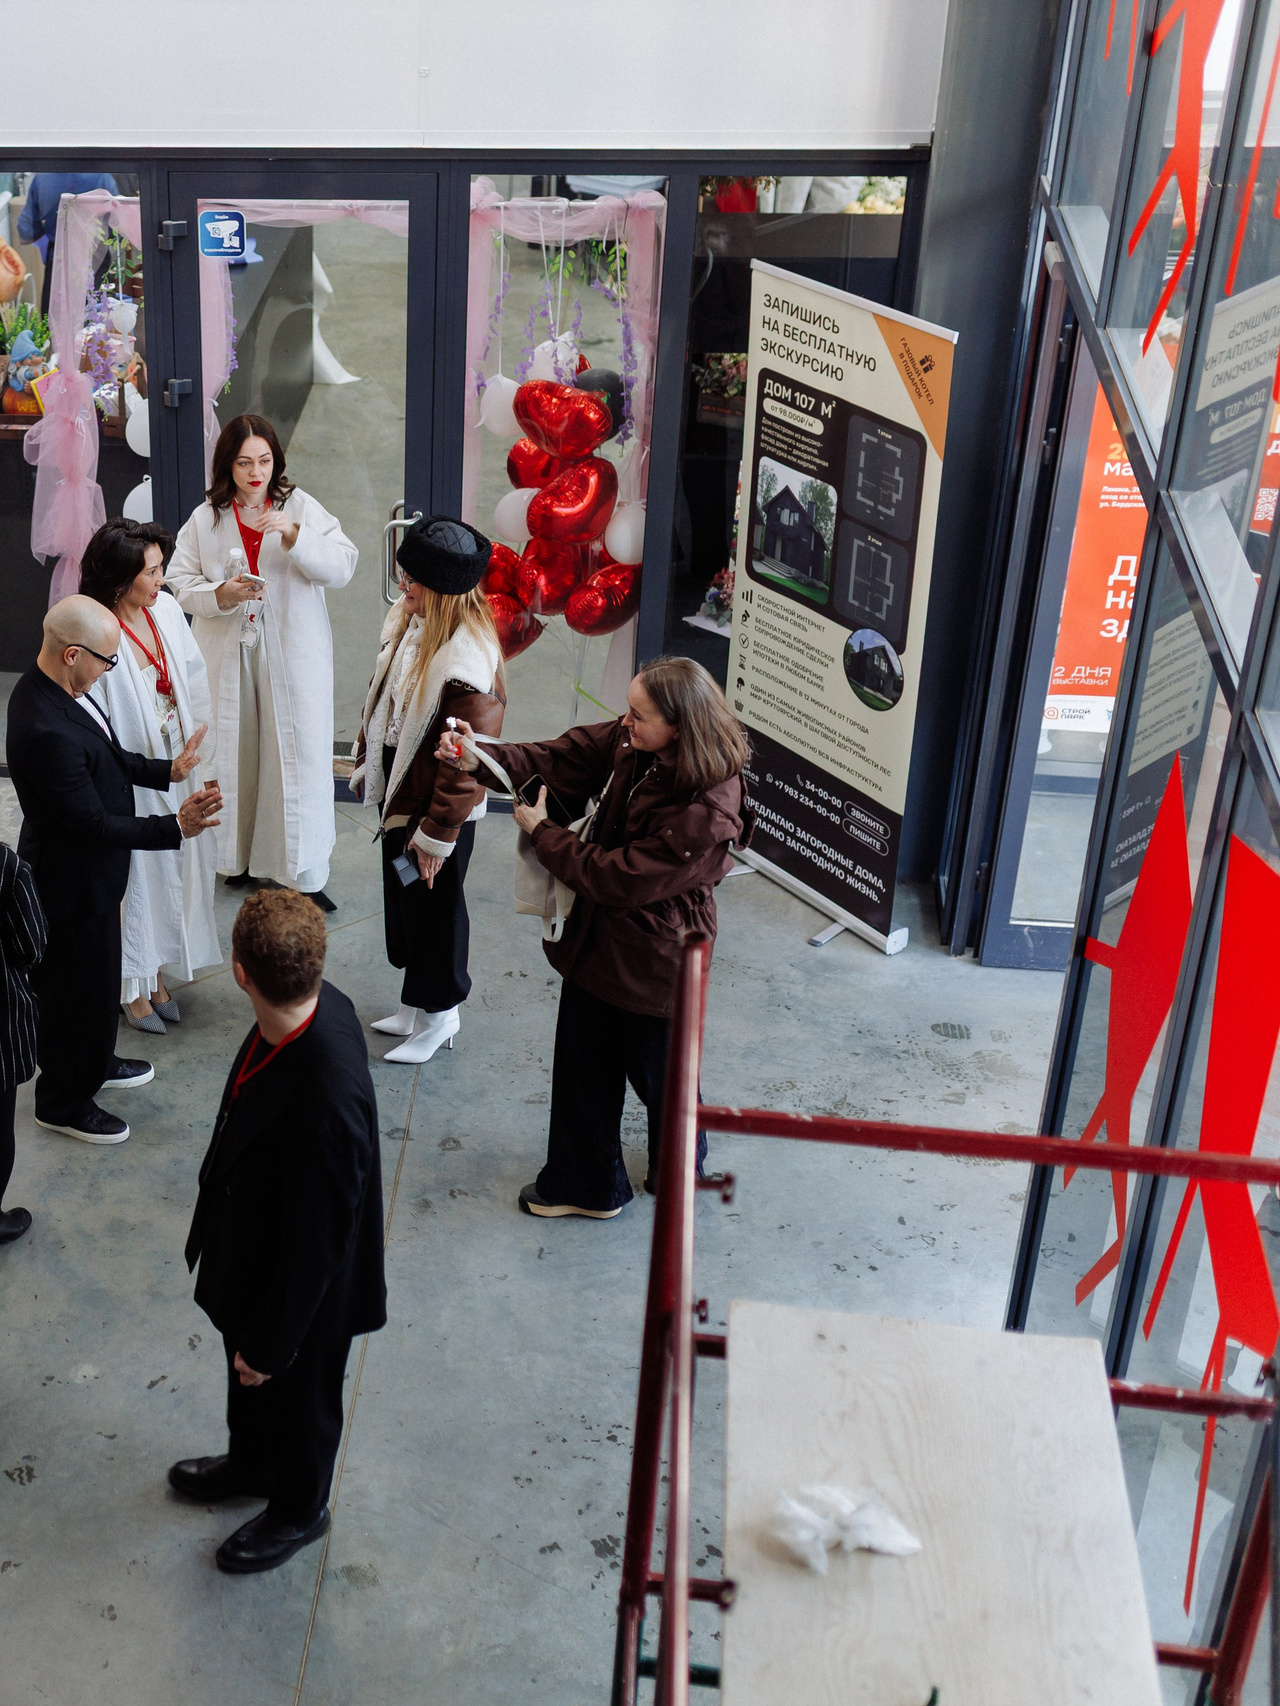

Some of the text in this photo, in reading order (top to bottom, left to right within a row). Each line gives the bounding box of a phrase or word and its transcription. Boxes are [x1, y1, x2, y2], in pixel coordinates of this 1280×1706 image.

[763, 292, 840, 335] ЗАПИШИСЬ
[760, 337, 844, 382] ЭКСКУРСИЮ
[762, 315, 876, 373] НА БЕСПЛАТНУЮ
[899, 336, 934, 405] ГАЗОВЫЙ КОТЕЛ
[901, 360, 923, 399] ПОДАРОК
[763, 377, 791, 403] ДОМ
[793, 390, 815, 412] 107
[760, 433, 828, 468] фасад дома декоративная
[761, 416, 771, 426] Дом
[771, 422, 794, 437] построен
[801, 435, 823, 448] высоко-
[761, 426, 819, 456] качественного кирпича,
[880, 430, 892, 440] этаж
[760, 441, 817, 472] штукатурка или кирпич.
[871, 537, 882, 547] этаж
[757, 593, 825, 633] СКОРОСТНОЙ ИНТЕРНЕТ
[761, 604, 788, 623] СОТОВАЯ
[789, 618, 807, 633] СВЯЗЬ
[753, 639, 824, 683] БЕСПЛАТНОЕ ОДОБРЕНИЕ
[754, 625, 829, 669] СОПРОВОЖДЕНИЕ СДЕЛКИ
[755, 616, 835, 664] БЕСПЛАТНОЕ ЮРИДИЧЕСКОЕ
[752, 648, 779, 667] ИПОТЕКИ
[785, 665, 806, 681] ЛЮБОМ
[806, 676, 824, 692] БАНКЕ
[1052, 677, 1109, 686] ВЫСТАВКИ
[1054, 666, 1111, 678] 2 ДНЯ
[750, 683, 866, 752] ОДИН ИЗ САМЫХ ЖИВОПИСНЫХ РАЙОНОВ
[751, 664, 798, 694] РАСПОЛОЖЕНИЕ
[810, 696, 837, 717] МИНУТАХ
[838, 712, 845, 721] ОТ
[846, 716, 869, 735] ГОРОДА
[1061, 707, 1091, 715] СТРОЙ
[748, 709, 882, 792] РЯДОМ ЕСТЬ АБСОЛЮТНО ВСЯ ИНФРАСТРУКТУРА
[750, 691, 761, 702] МКР
[762, 698, 803, 725] КРУТОЯРСКИЙ,
[808, 723, 836, 744] ШАГОВОЙ
[836, 739, 879, 769] ДОСТУПНОСТИ
[879, 764, 891, 777] ЛЕС
[774, 779, 881, 851] +7 983 234-00-00 ПИШИТЕ
[804, 779, 884, 835] 34-00-00 ЗВОНИТЕ
[756, 816, 880, 904] ЛАГАЮ ЗАГОРОДНУЮ ЖИЗНЬ.
[795, 826, 853, 871] ЗАГОРОДНЫЕ
[854, 864, 886, 893] ДОМА,
